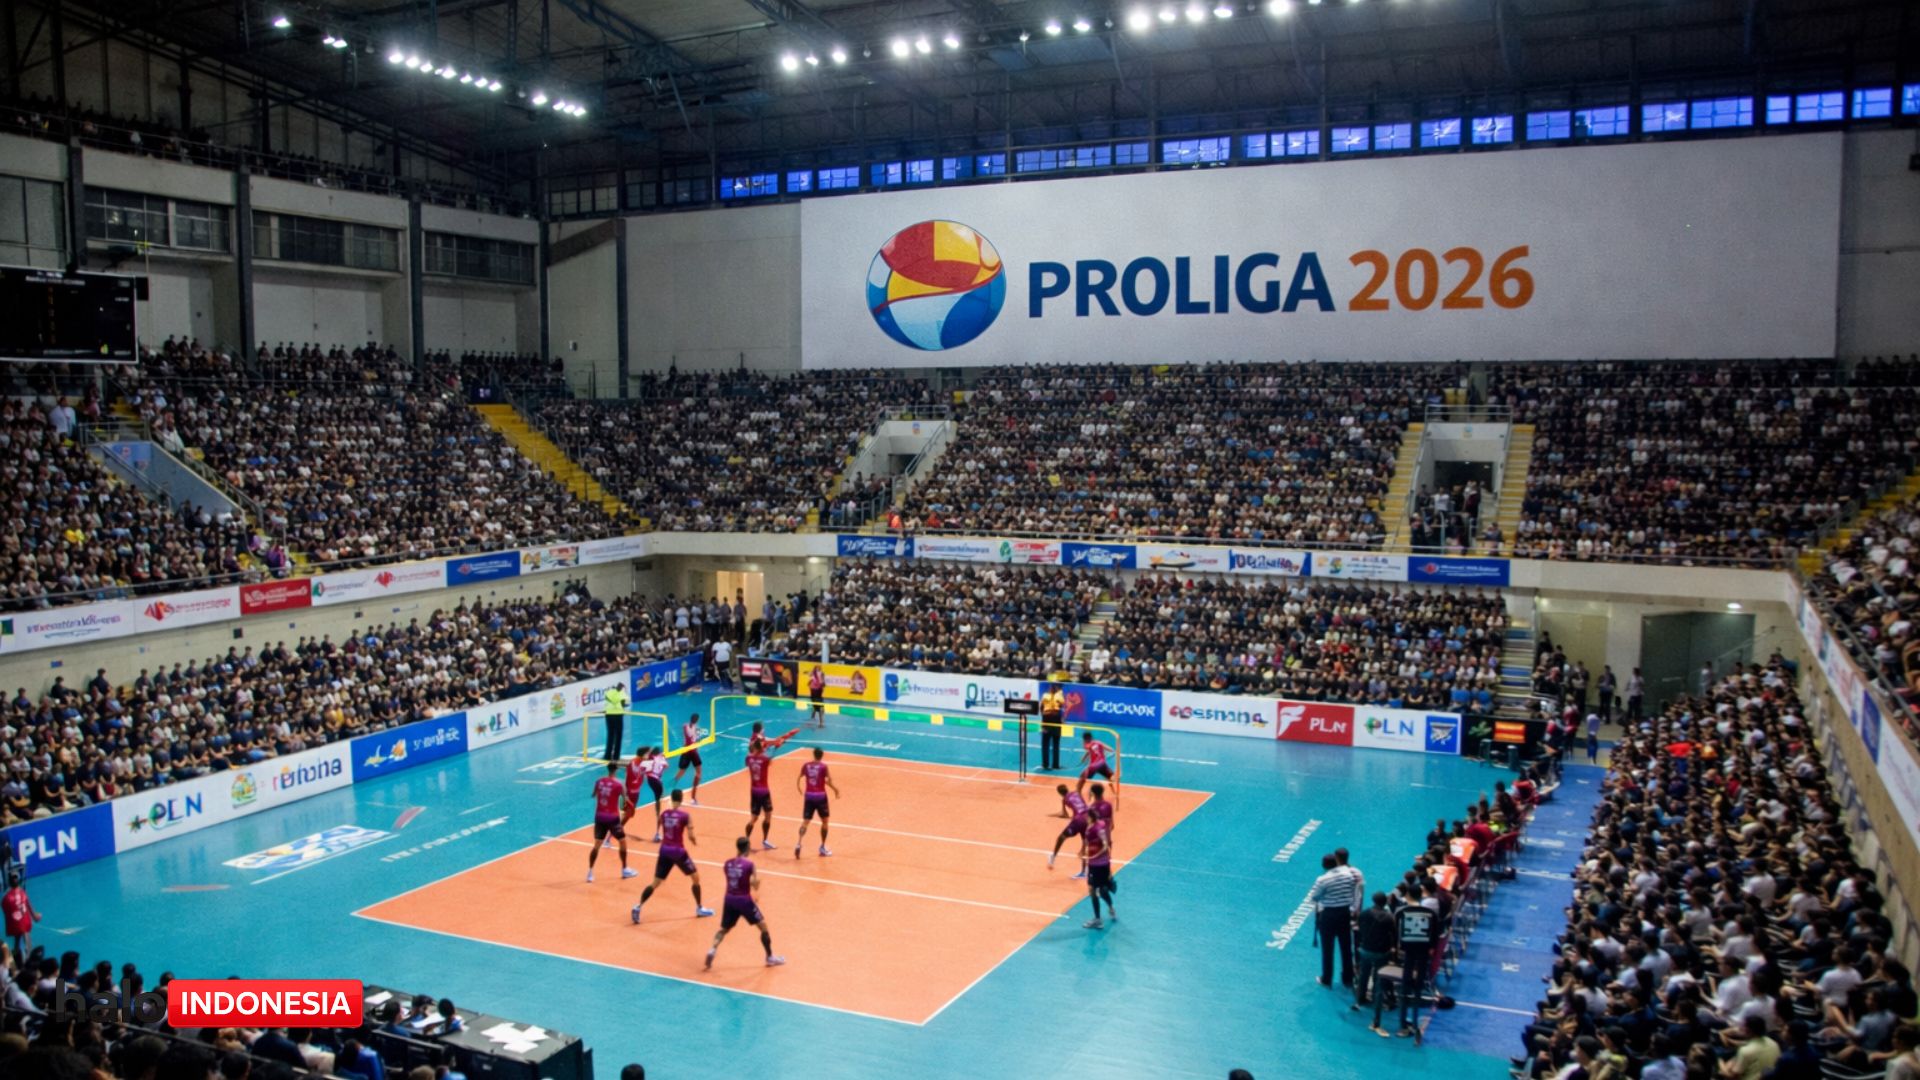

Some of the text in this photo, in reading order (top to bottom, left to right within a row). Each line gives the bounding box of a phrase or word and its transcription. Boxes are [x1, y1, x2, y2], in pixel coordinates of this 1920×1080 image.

[1027, 245, 1535, 319] PROLIGA 2026
[18, 826, 78, 865] PLN
